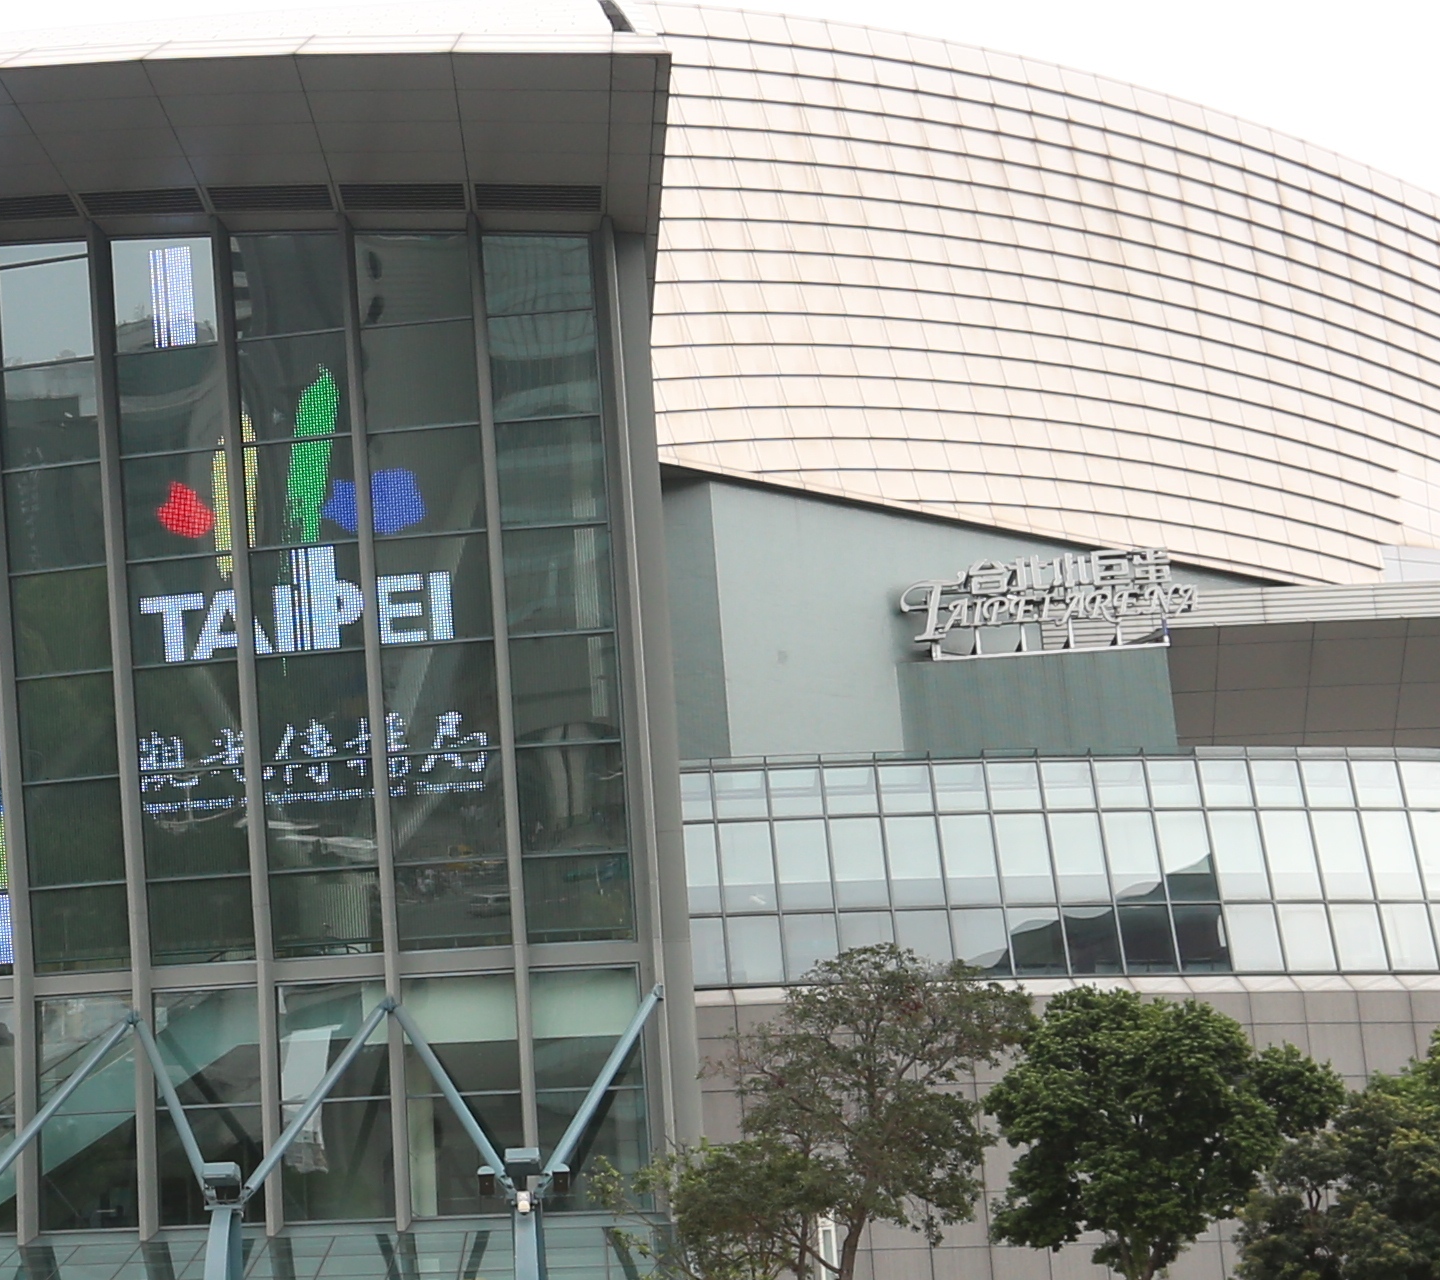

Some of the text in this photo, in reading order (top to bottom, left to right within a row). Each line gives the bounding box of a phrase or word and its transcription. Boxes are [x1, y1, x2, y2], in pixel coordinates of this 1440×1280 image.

[139, 546, 455, 662] TAIPEI
[900, 571, 1199, 642] TAIPEI ARENA
[970, 547, 1172, 595] 台北小巨蛋
